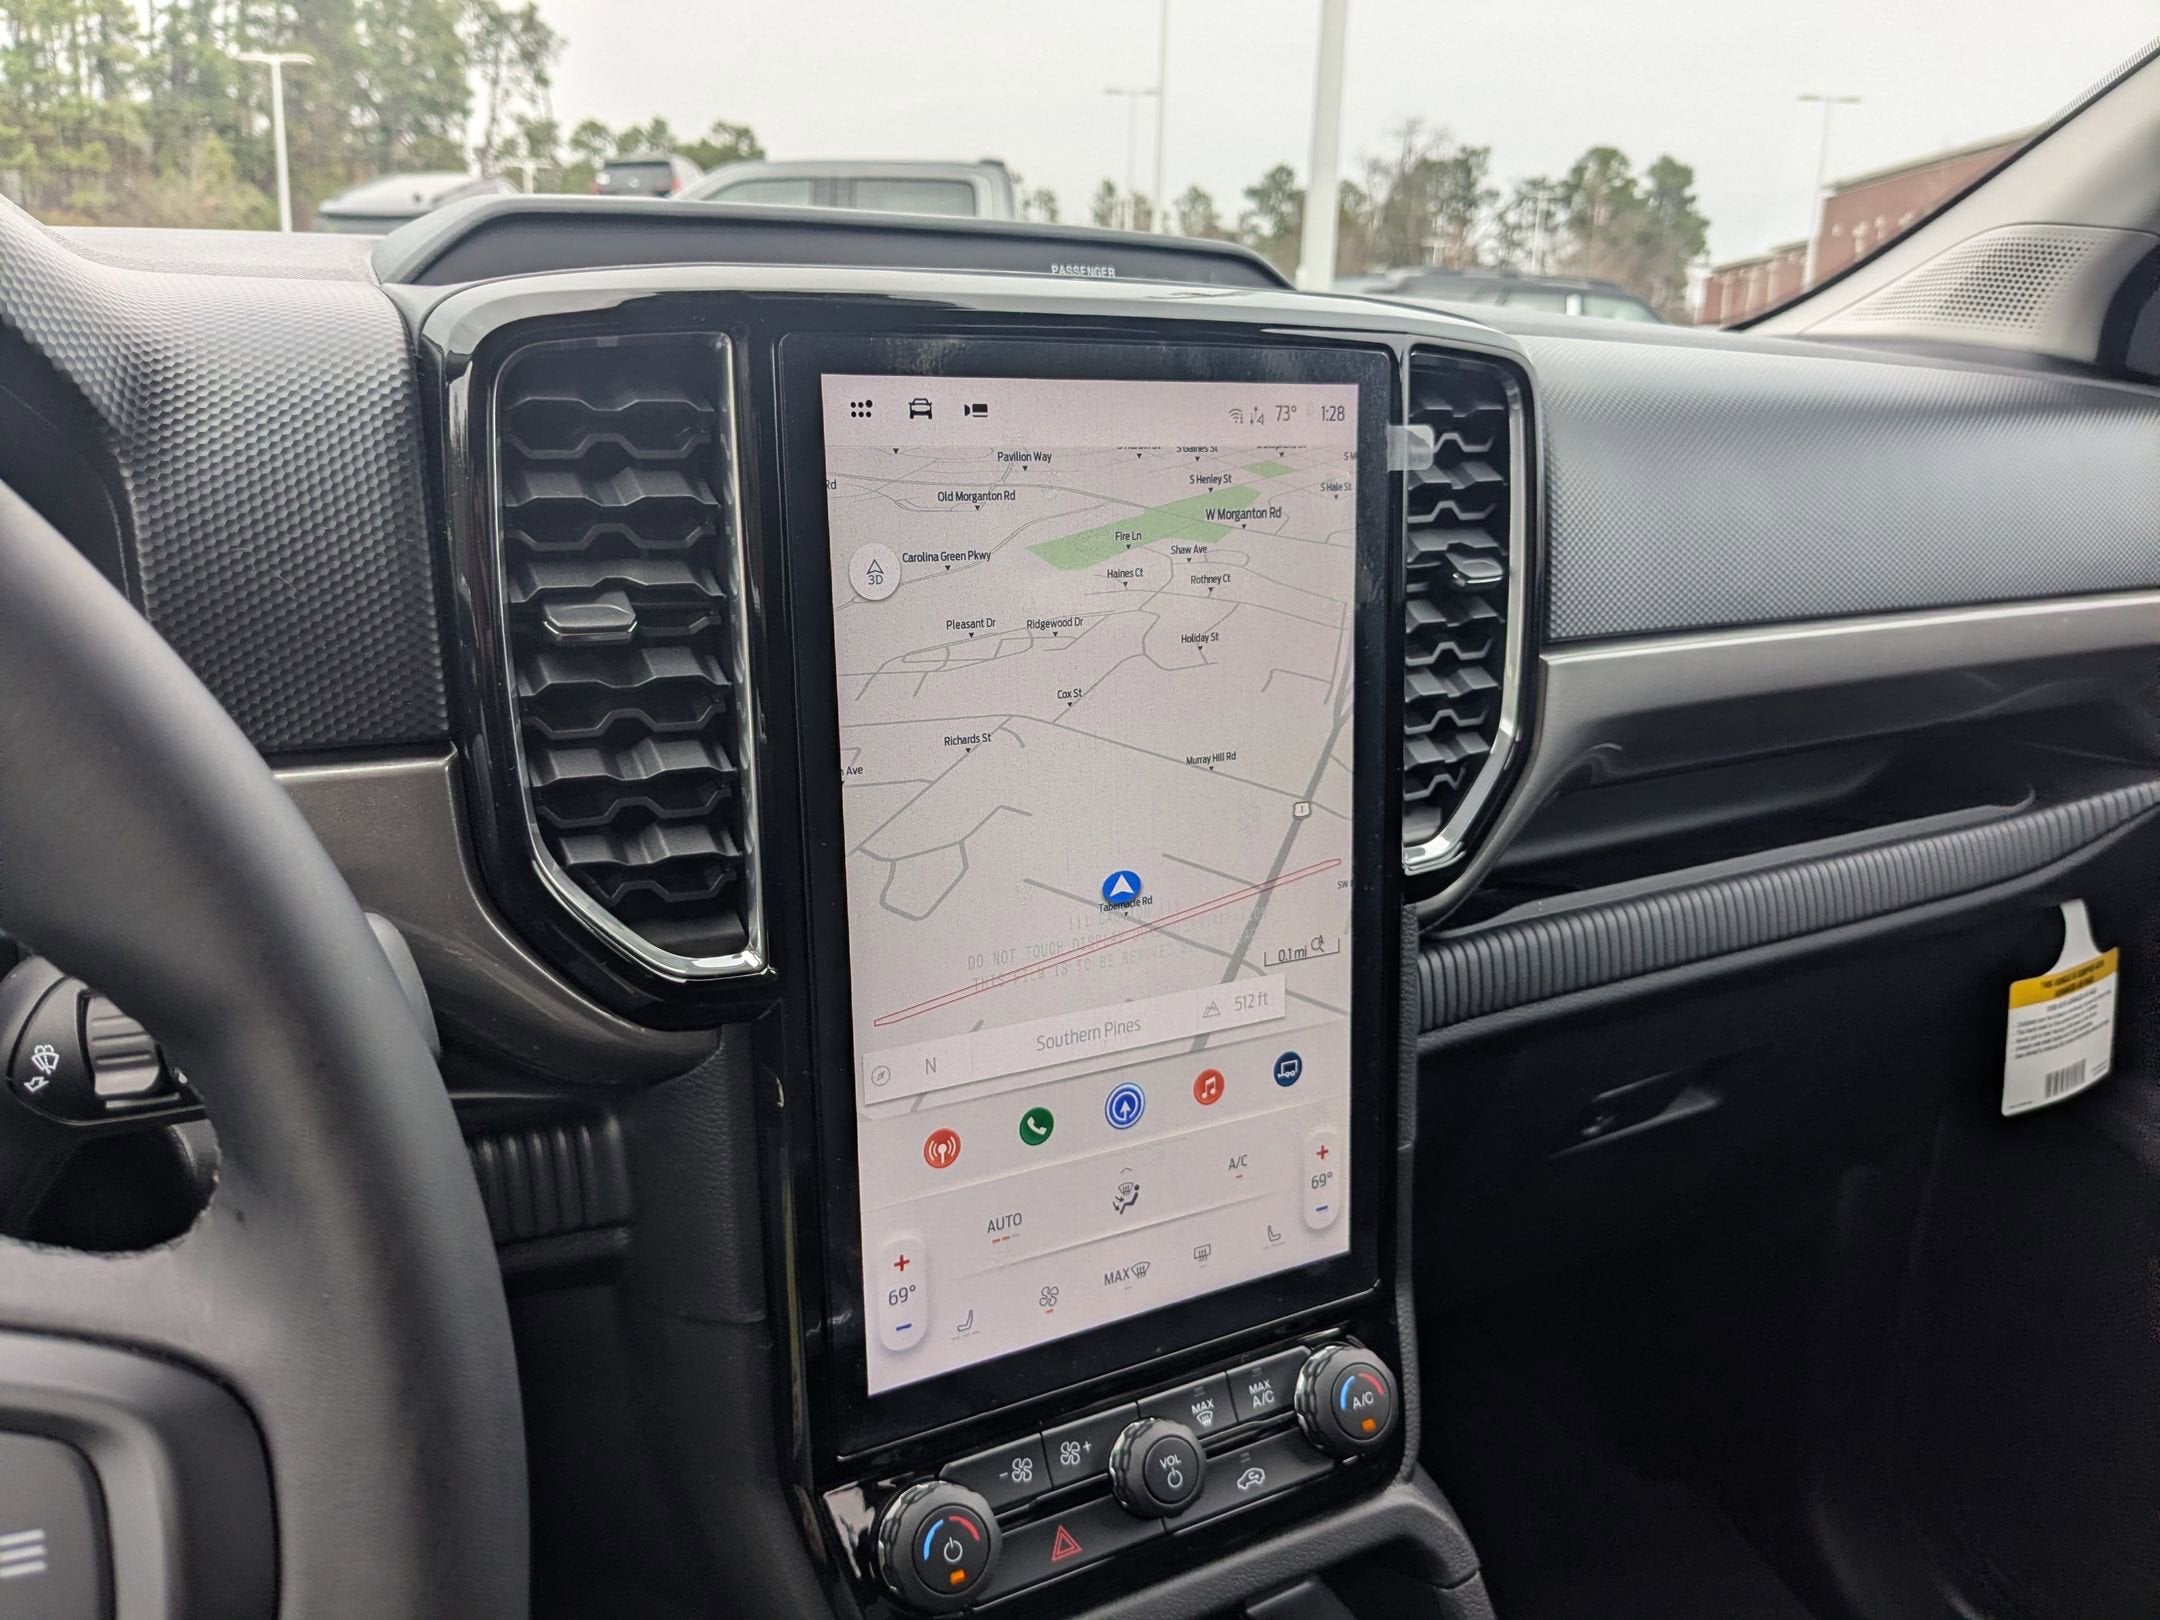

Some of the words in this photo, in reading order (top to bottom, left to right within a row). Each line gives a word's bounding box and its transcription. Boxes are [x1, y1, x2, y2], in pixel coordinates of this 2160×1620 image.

[1051, 264, 1116, 278] PASSENGER
[1321, 405, 1345, 422] 1:28
[997, 451, 1031, 462] Pavilion
[1032, 451, 1052, 463] Way
[1190, 474, 1195, 485] S
[1196, 474, 1221, 486] Henley
[1223, 474, 1232, 484] St
[1320, 482, 1326, 492] S
[1326, 482, 1343, 492] Hale
[937, 491, 954, 502] Old
[955, 491, 1002, 504] Morganton
[1003, 490, 1016, 501] Rd
[1206, 509, 1216, 520] W
[1217, 508, 1268, 523] Morganton
[1269, 506, 1282, 519] Rd
[1115, 531, 1130, 542] Fire
[1132, 531, 1142, 541] Ln
[902, 552, 939, 563] Carolina
[940, 551, 966, 563] Green
[968, 550, 992, 562] Pkwy
[1171, 544, 1193, 555] Shaw
[1194, 544, 1208, 554] Ave
[868, 574, 884, 586] 3D
[1107, 568, 1133, 579] Haines
[1134, 567, 1144, 578] Ct
[1190, 574, 1221, 586] Rothney
[1222, 573, 1231, 583] Ct
[946, 619, 985, 630] Pleasant
[987, 618, 996, 629] Dr
[1026, 618, 1072, 631] Ridgewood
[1073, 617, 1084, 628] Dr
[1181, 633, 1209, 645] Holiday
[1210, 632, 1219, 643] St
[1057, 689, 1071, 700] Cox
[1073, 688, 1082, 698] St
[944, 734, 980, 746] Richards
[982, 733, 991, 744] St
[1186, 754, 1211, 767] Murray
[1212, 752, 1225, 763] Hill
[1226, 751, 1236, 762] Rd
[846, 766, 864, 776] Ave
[1142, 895, 1153, 906] Rd
[968, 953, 984, 970] DO
[993, 948, 1016, 966] NOT
[1025, 940, 1064, 959] TOUCH
[1278, 947, 1292, 962] 0.1
[1293, 944, 1307, 960] mi
[1234, 993, 1255, 1012] 512
[1258, 990, 1269, 1007] ft
[1036, 1025, 1101, 1052] Southern
[1105, 1018, 1141, 1038] Pines
[925, 1057, 937, 1075] N
[1228, 1154, 1248, 1170] A/C
[1311, 1171, 1333, 1190] 69°
[987, 1212, 1023, 1234] AUTO
[1104, 1267, 1130, 1286] MAX
[888, 1284, 917, 1306] 69°
[1249, 1379, 1272, 1394] MAX
[1252, 1389, 1275, 1409] A/C
[1352, 1391, 1375, 1411] A/C
[1191, 1398, 1215, 1415] MAX
[1159, 1453, 1182, 1470] VOL
